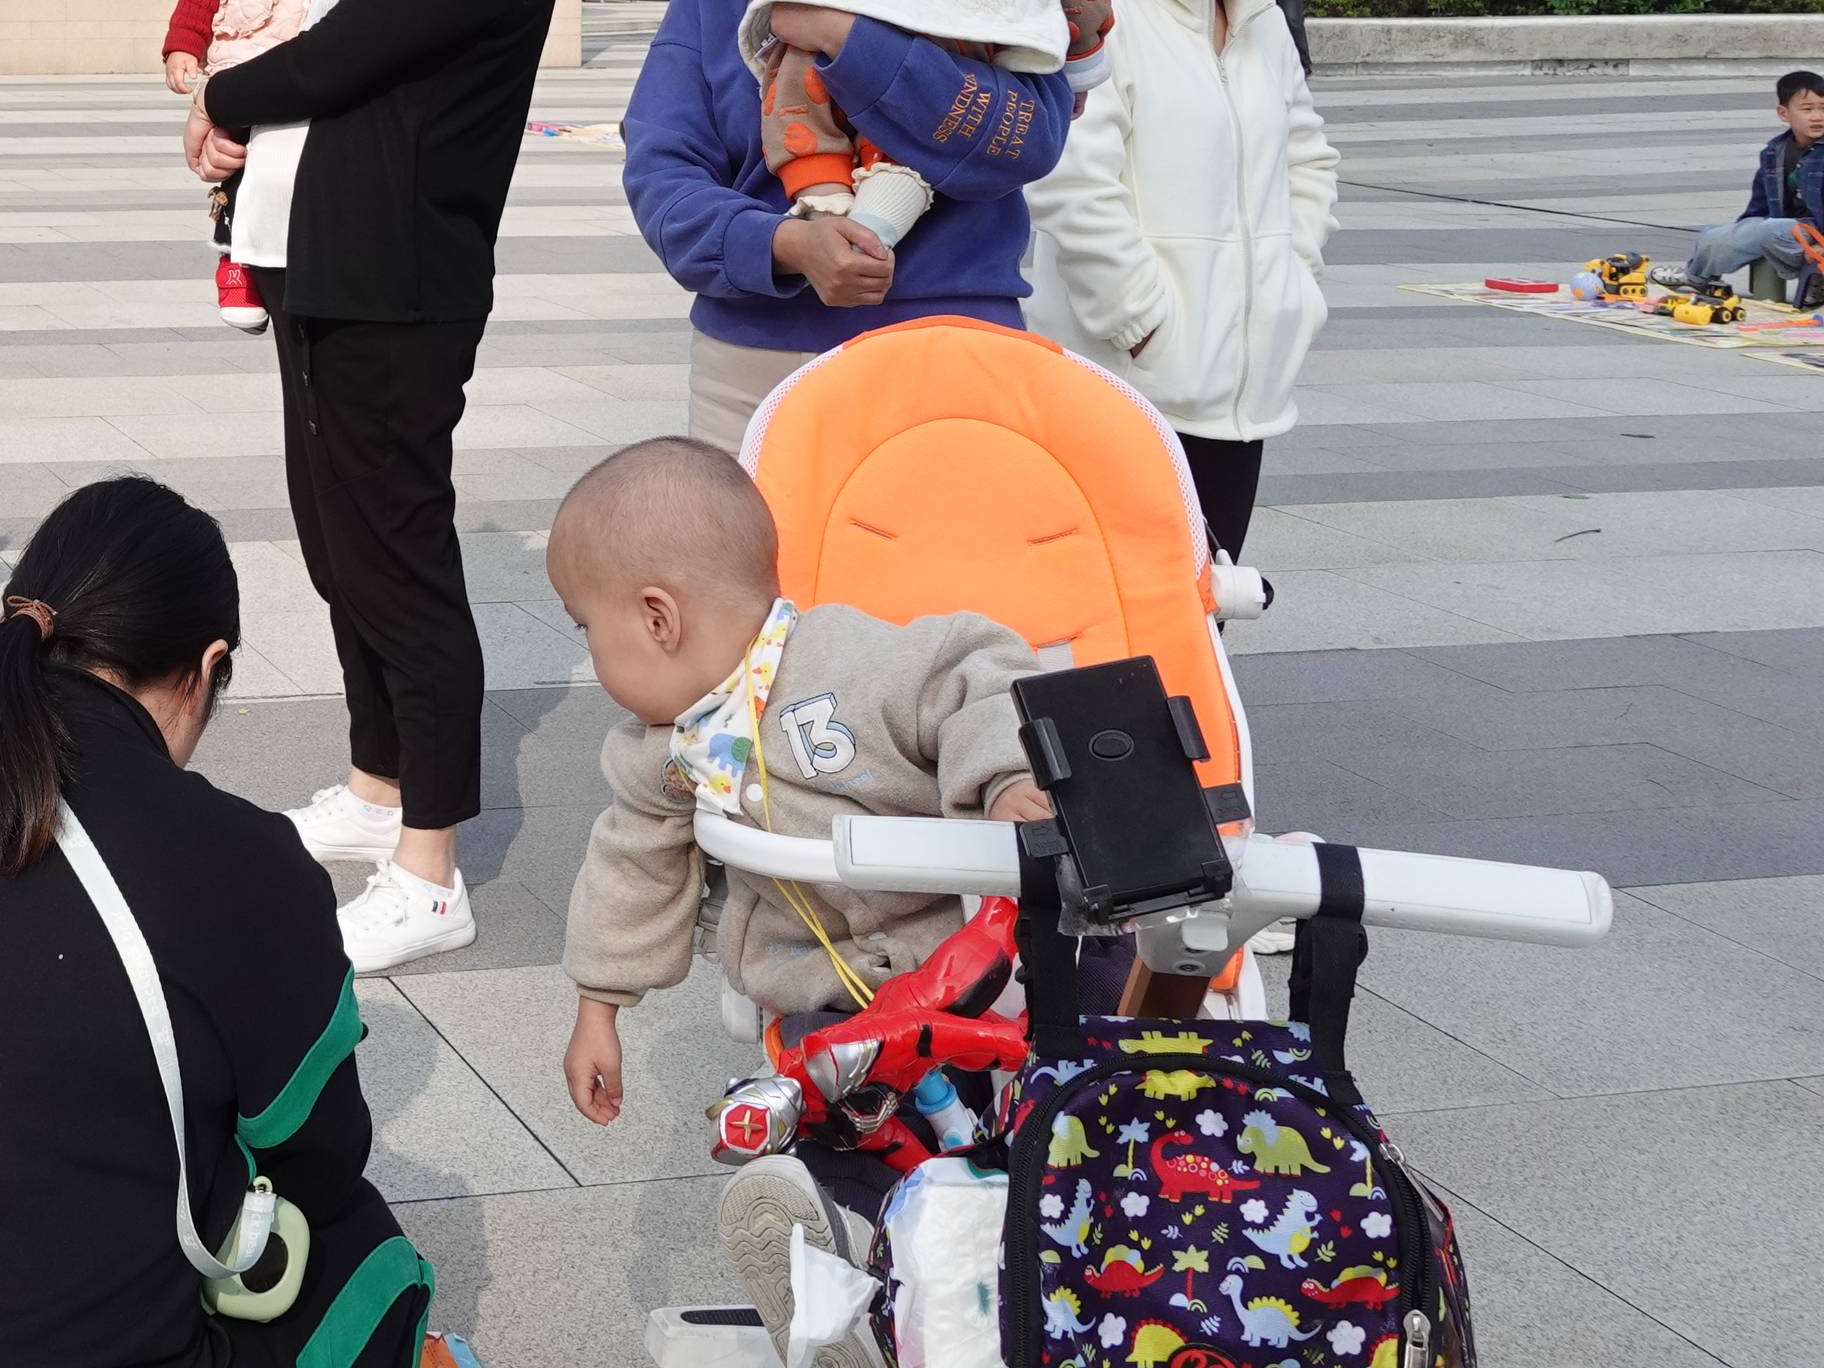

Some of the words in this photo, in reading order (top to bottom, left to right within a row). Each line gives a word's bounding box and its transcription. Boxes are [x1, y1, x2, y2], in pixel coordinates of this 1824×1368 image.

[958, 92, 991, 137] WITH
[986, 89, 1018, 155] PEOPLE
[1007, 99, 1035, 159] TREAT
[779, 692, 857, 779] 13
